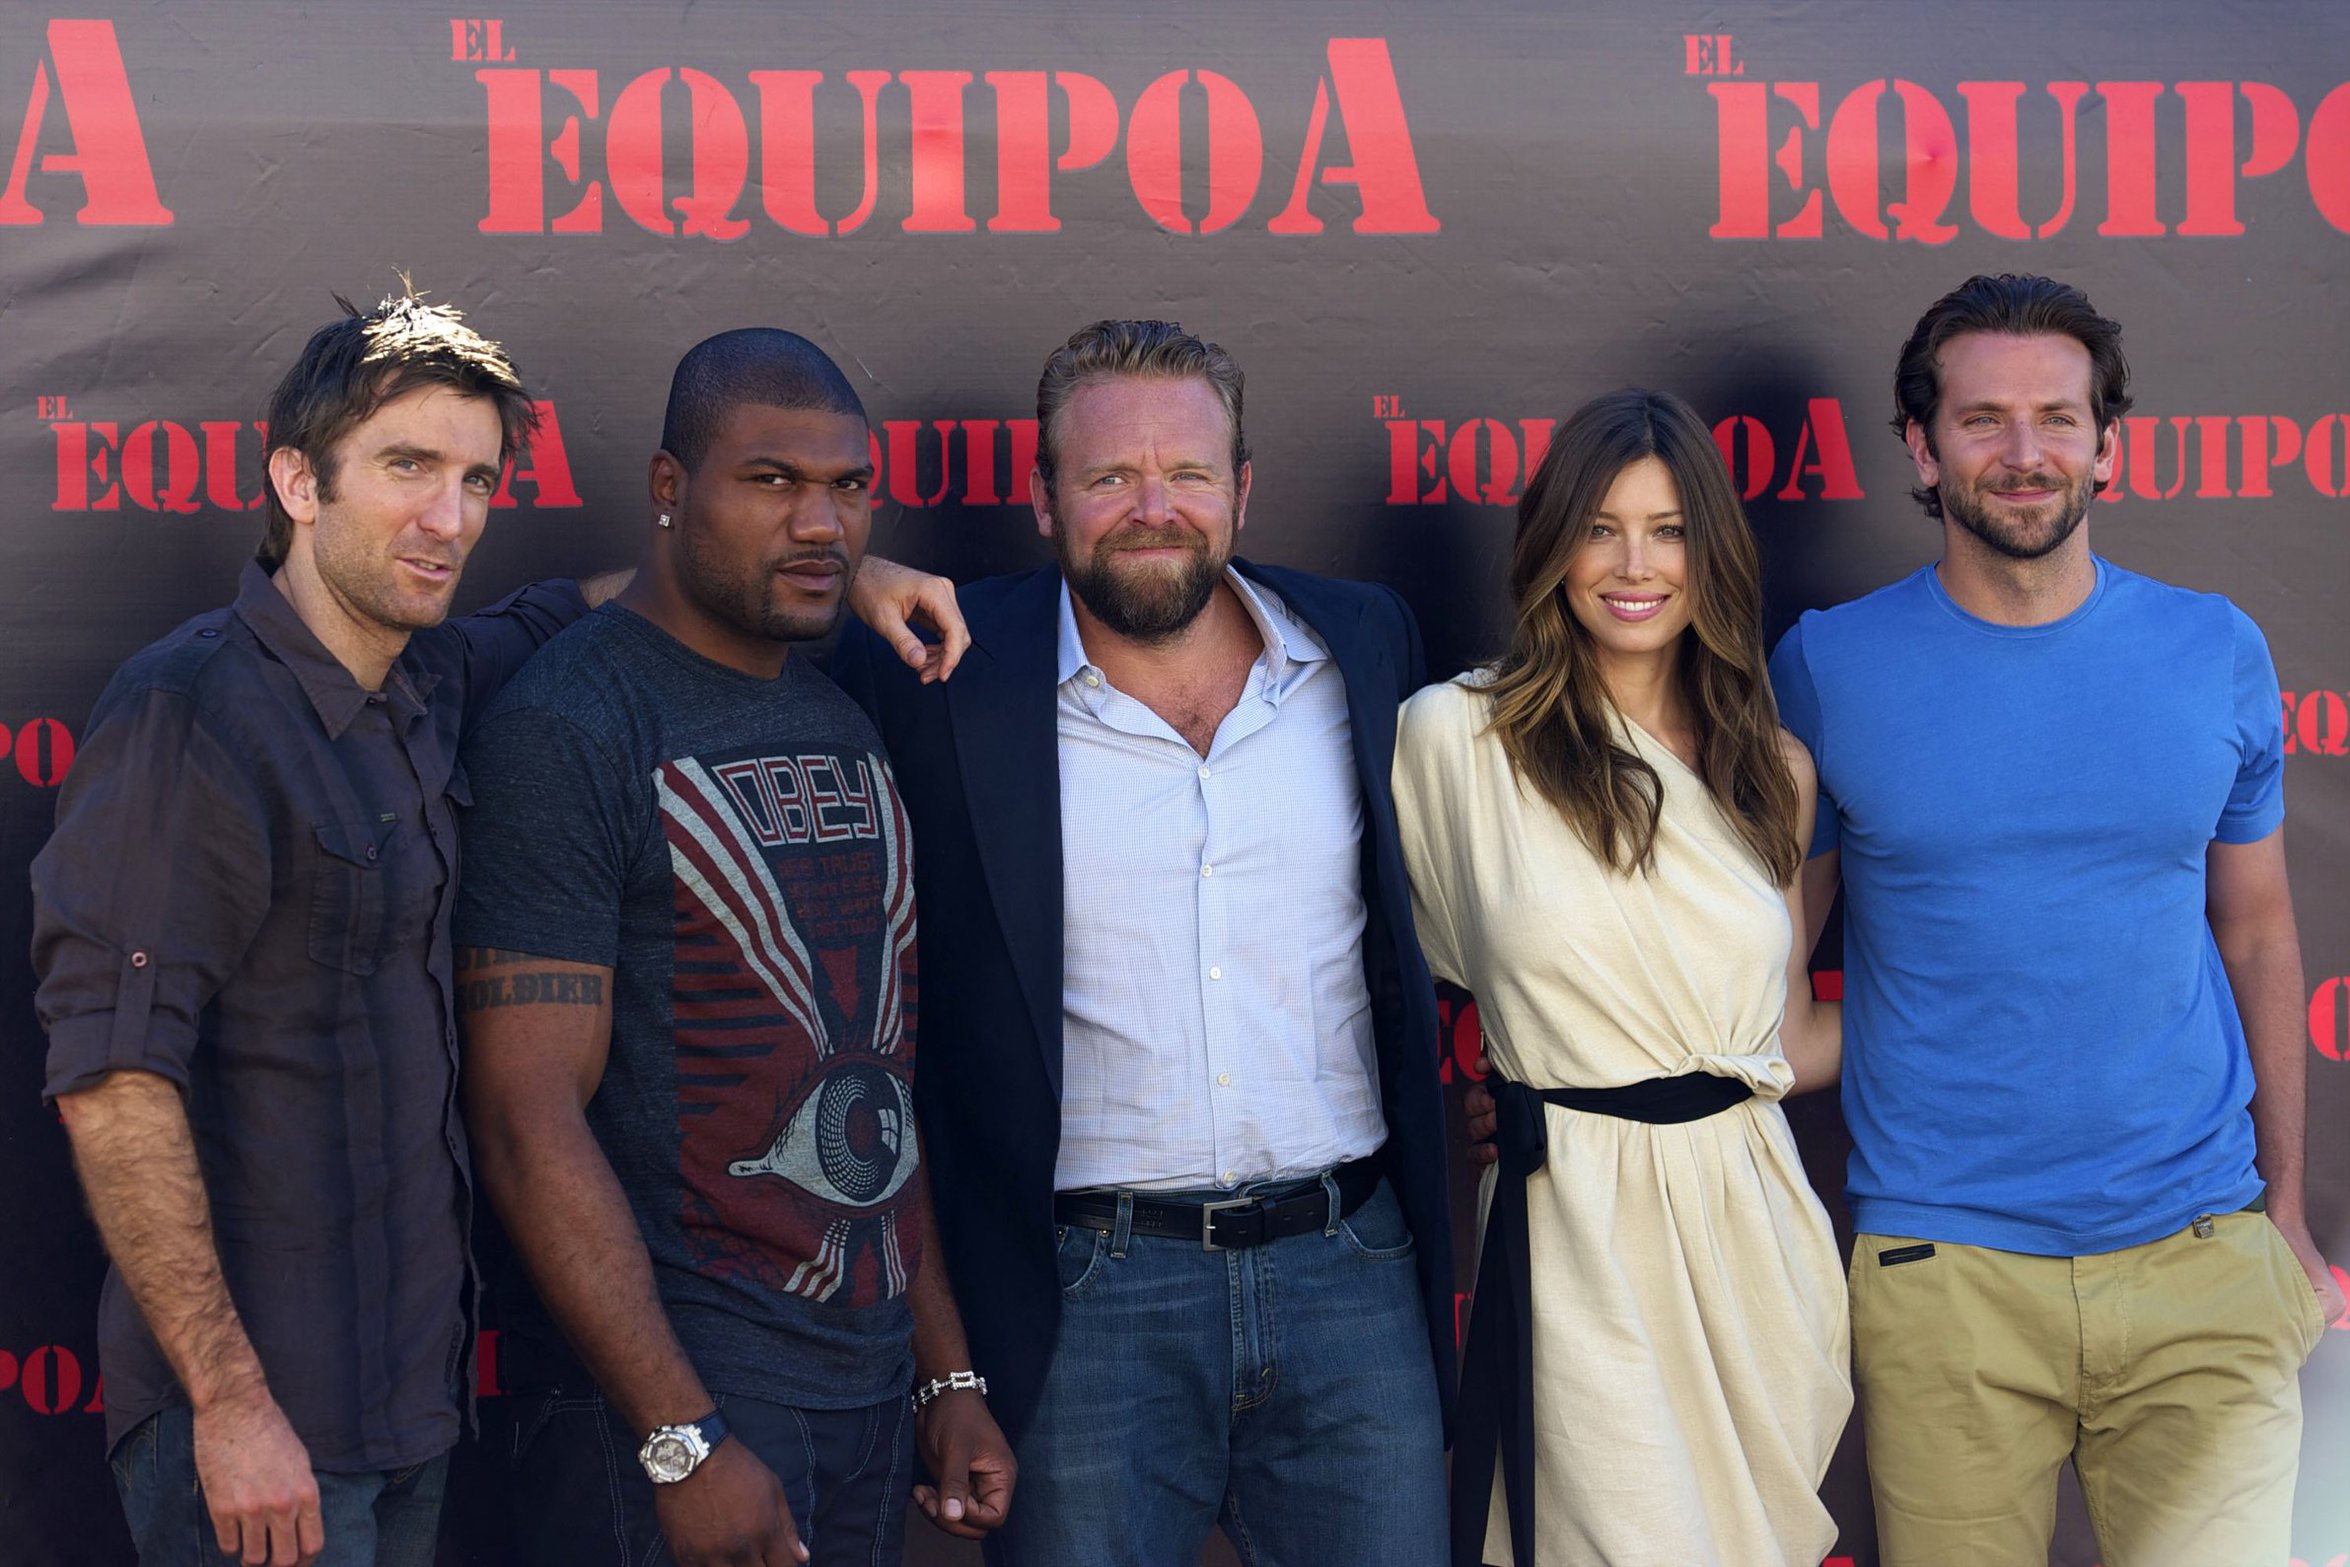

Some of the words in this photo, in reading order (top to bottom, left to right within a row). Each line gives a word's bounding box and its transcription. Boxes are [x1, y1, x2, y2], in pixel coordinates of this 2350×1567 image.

[451, 20, 517, 63] EL
[1685, 35, 1746, 76] EL
[37, 396, 74, 420] EL
[1373, 395, 1406, 419] EL
[51, 420, 268, 513] EQU
[711, 755, 879, 847] OBEY
